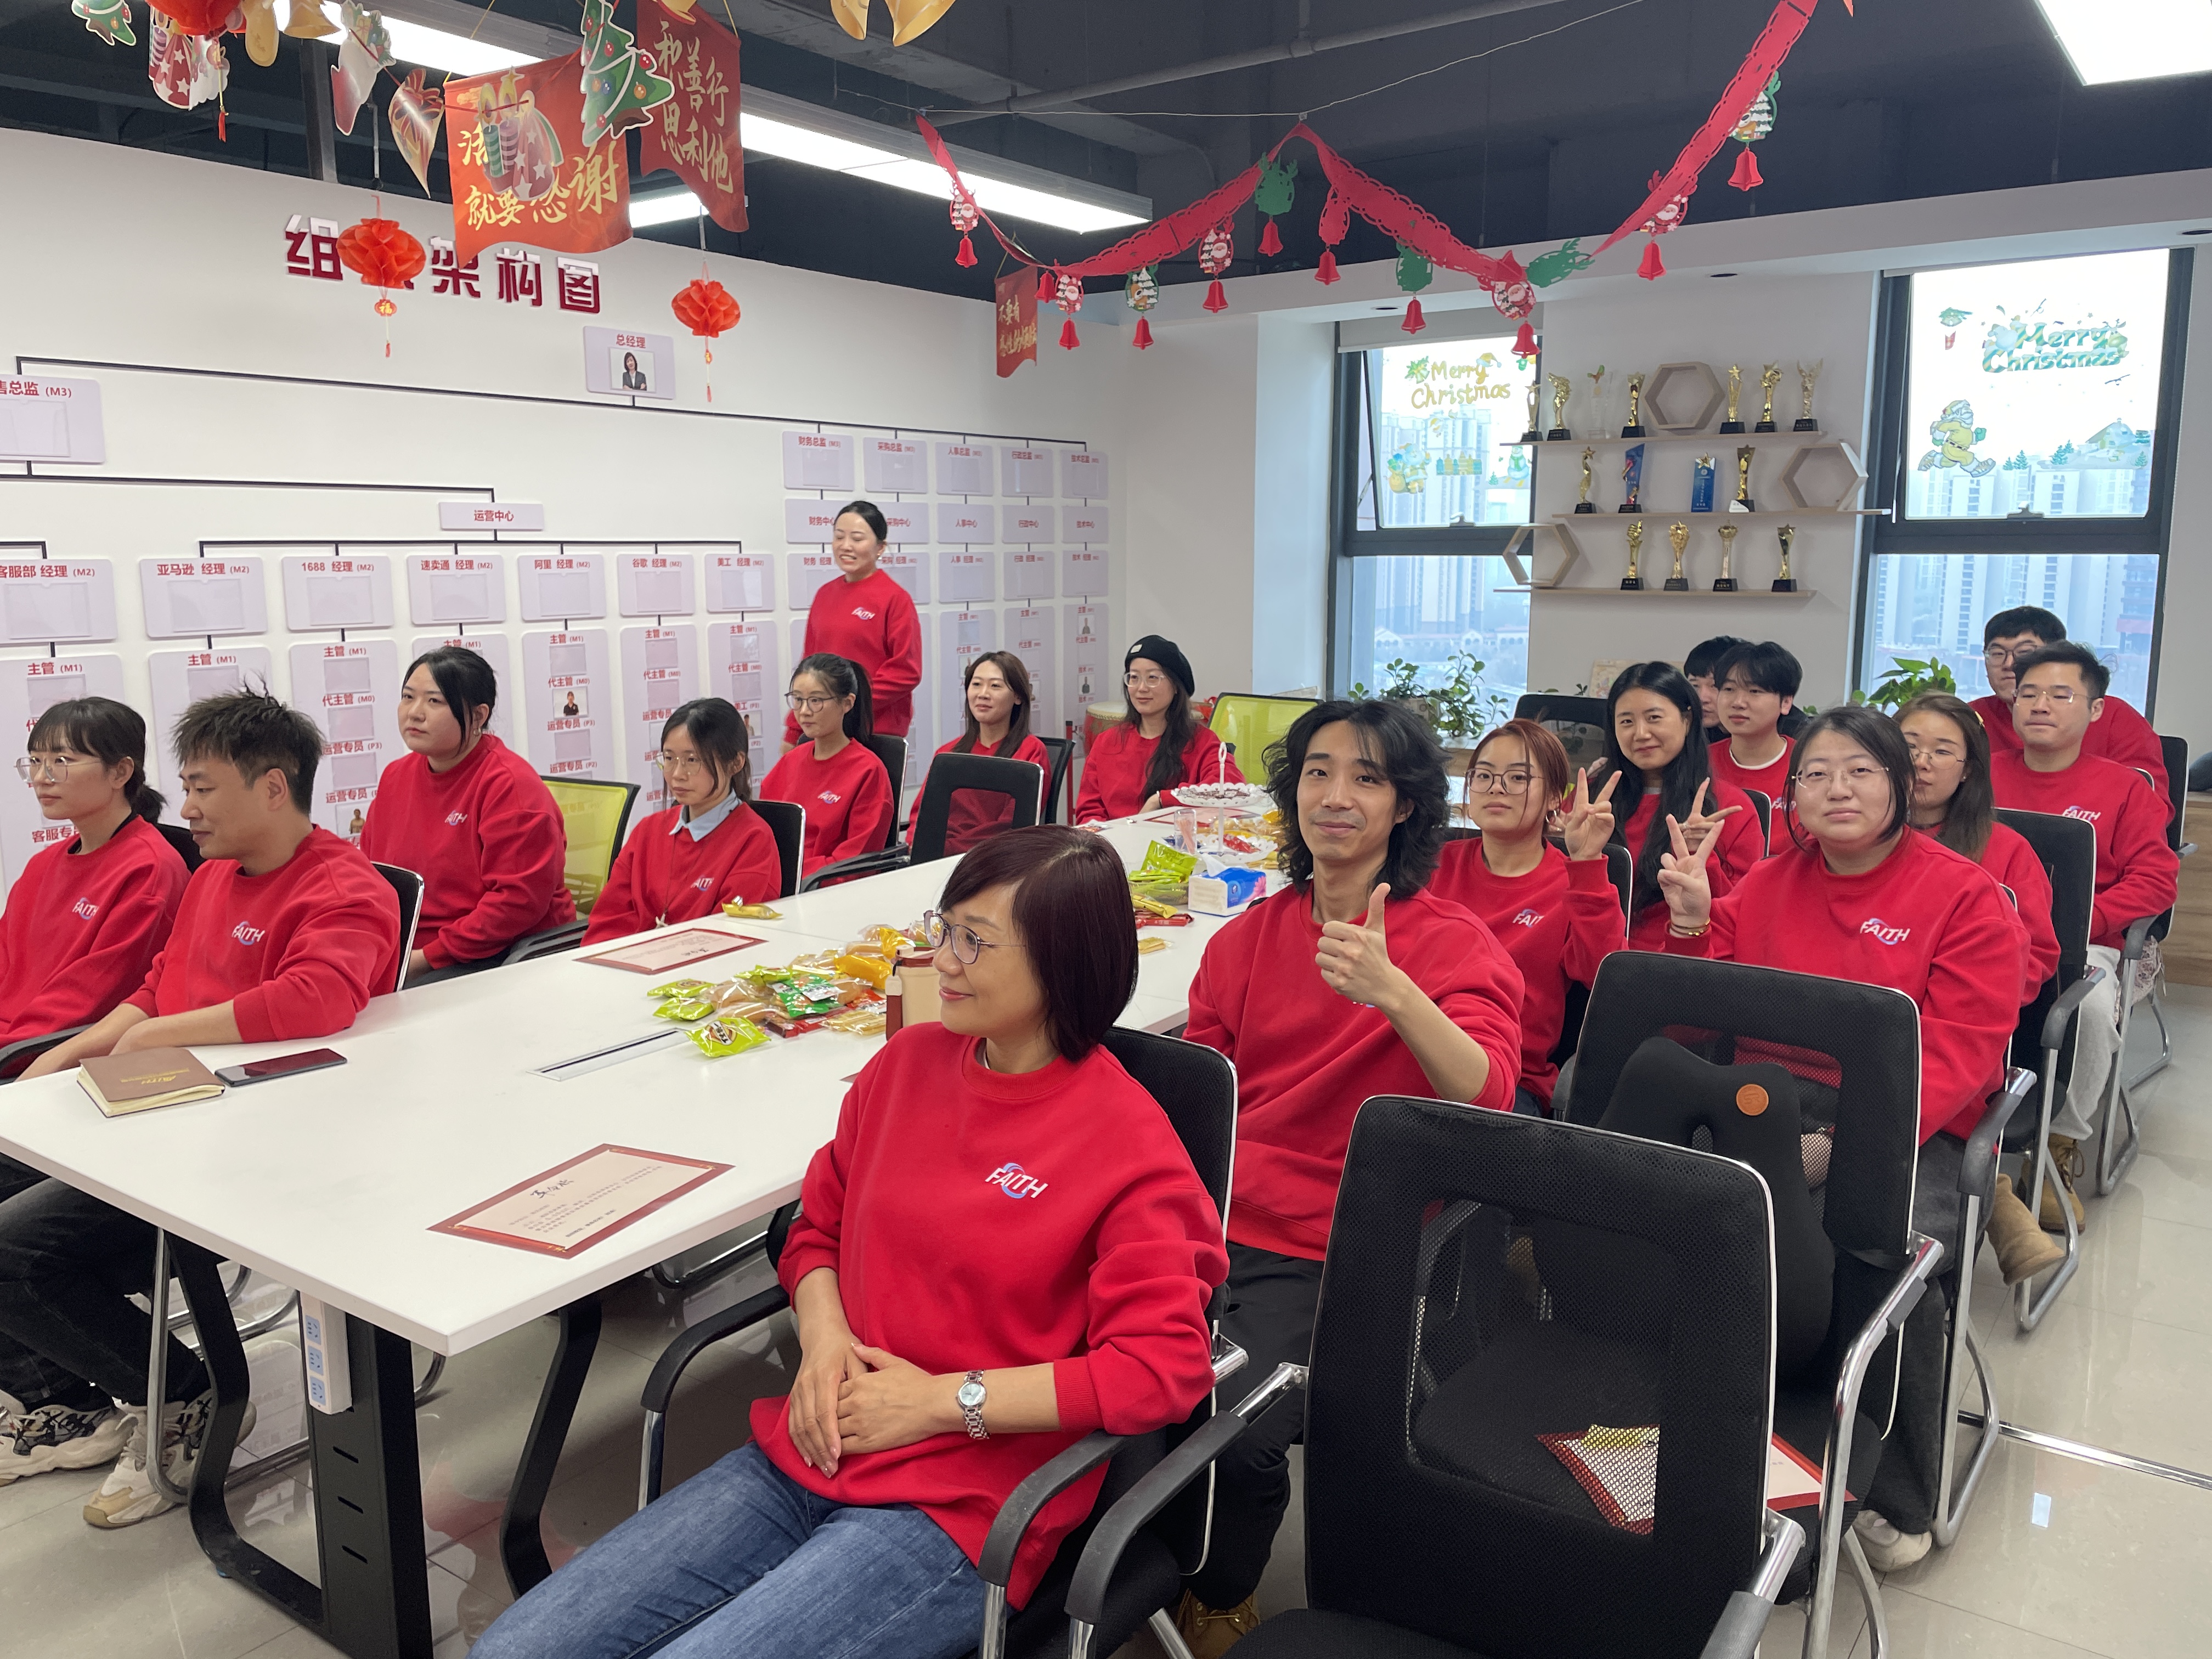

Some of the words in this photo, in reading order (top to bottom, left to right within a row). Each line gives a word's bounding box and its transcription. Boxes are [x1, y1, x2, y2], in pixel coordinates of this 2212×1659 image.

[285, 213, 600, 314] 组架构图
[616, 333, 646, 348] 总经理
[2014, 322, 2109, 349] Merry
[1982, 348, 2121, 373] Christmas
[1431, 360, 1489, 385] Merry
[46, 386, 72, 398] (M3)
[1411, 382, 1510, 409] Christmas
[474, 510, 514, 522] 运营中心
[157, 564, 195, 576] 亚马逊
[201, 563, 225, 575] 经理
[230, 566, 250, 574] (M2)
[302, 562, 325, 572] 1688
[331, 561, 353, 572] 经理
[357, 563, 374, 572] (M2)
[421, 560, 450, 571] 速卖通
[455, 560, 474, 570] 经理
[477, 562, 493, 570] (M2)
[534, 559, 551, 569] 阿里
[556, 559, 573, 569] 经理
[41, 565, 68, 578] 经理
[73, 567, 95, 577] (M2)
[851, 608, 875, 620] FAITH
[645, 629, 659, 639] 主管
[730, 625, 743, 634] 主管
[550, 634, 566, 644] 主管
[324, 646, 345, 657] 主管
[349, 647, 366, 656] (M1)
[188, 653, 212, 666] 主管
[217, 654, 236, 664] (M1)
[27, 662, 54, 675] 主管
[60, 664, 82, 673] (M1)
[644, 670, 665, 680] 代主管
[548, 676, 573, 687] 代主管
[323, 694, 353, 706] 代主管
[548, 719, 580, 731] 运营专员
[323, 741, 363, 755] 运营专员
[368, 742, 382, 751] (P3)
[550, 760, 583, 774] 运营专员
[326, 788, 367, 803] 运营专员
[817, 792, 840, 803] FAITH
[2062, 809, 2101, 820] FAITH
[72, 901, 99, 917] FAITH
[1513, 913, 1545, 927] FAIT
[232, 925, 266, 943] FAITH
[1860, 921, 1910, 941] FAITH
[985, 1167, 1048, 1198] FAITH
